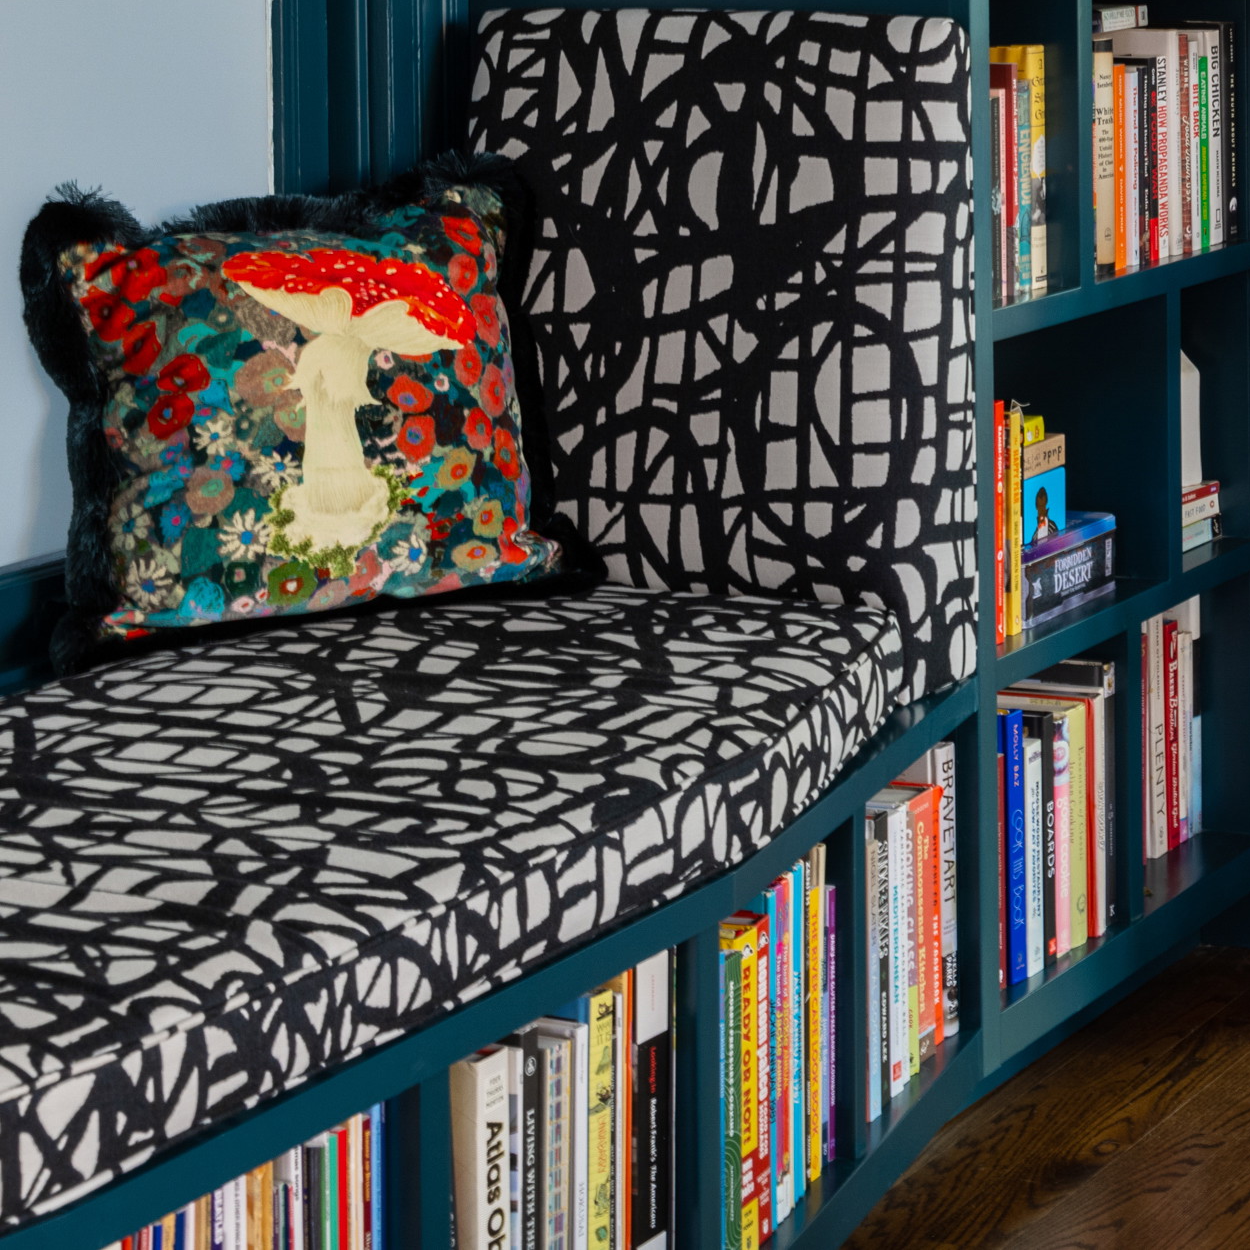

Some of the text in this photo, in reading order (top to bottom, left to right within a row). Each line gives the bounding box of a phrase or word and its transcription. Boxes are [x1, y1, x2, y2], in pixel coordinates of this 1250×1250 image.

[1192, 83, 1200, 108] BITE
[1210, 45, 1221, 139] BIG CHICKEN
[1132, 147, 1140, 191] Policing
[1157, 58, 1169, 239] STANLEY HOW PROPAGANDA WORKS
[1043, 445, 1063, 465] dude
[1053, 561, 1094, 595] DESERT
[1054, 546, 1093, 576] FORBIDDEN
[1168, 661, 1179, 698] BAKER
[1154, 722, 1165, 817] PLENTY
[878, 839, 889, 886] SMOKE
[942, 758, 956, 903] BRAVETART
[1011, 809, 1025, 931] COOK THIS BOOK
[1046, 799, 1055, 879] BOARDS
[1056, 797, 1070, 899] good cookie
[870, 894, 878, 948] SLATER
[906, 828, 915, 972] COOKING CLASS
[916, 821, 927, 1014] Commonsense Kitchen
[777, 999, 783, 1007] of
[871, 952, 879, 992] REAL
[648, 1046, 658, 1082] Looking
[743, 965, 752, 1147] READY OR NOT!
[756, 955, 770, 1101] nom nom paleo
[486, 1121, 506, 1205] Atlas
[526, 1108, 536, 1250] LIVING WITH THE
[649, 1097, 658, 1229] Robert Frank's The Americans
[213, 1189, 223, 1245] BEATLES
[578, 1181, 586, 1238] HOKUSAI
